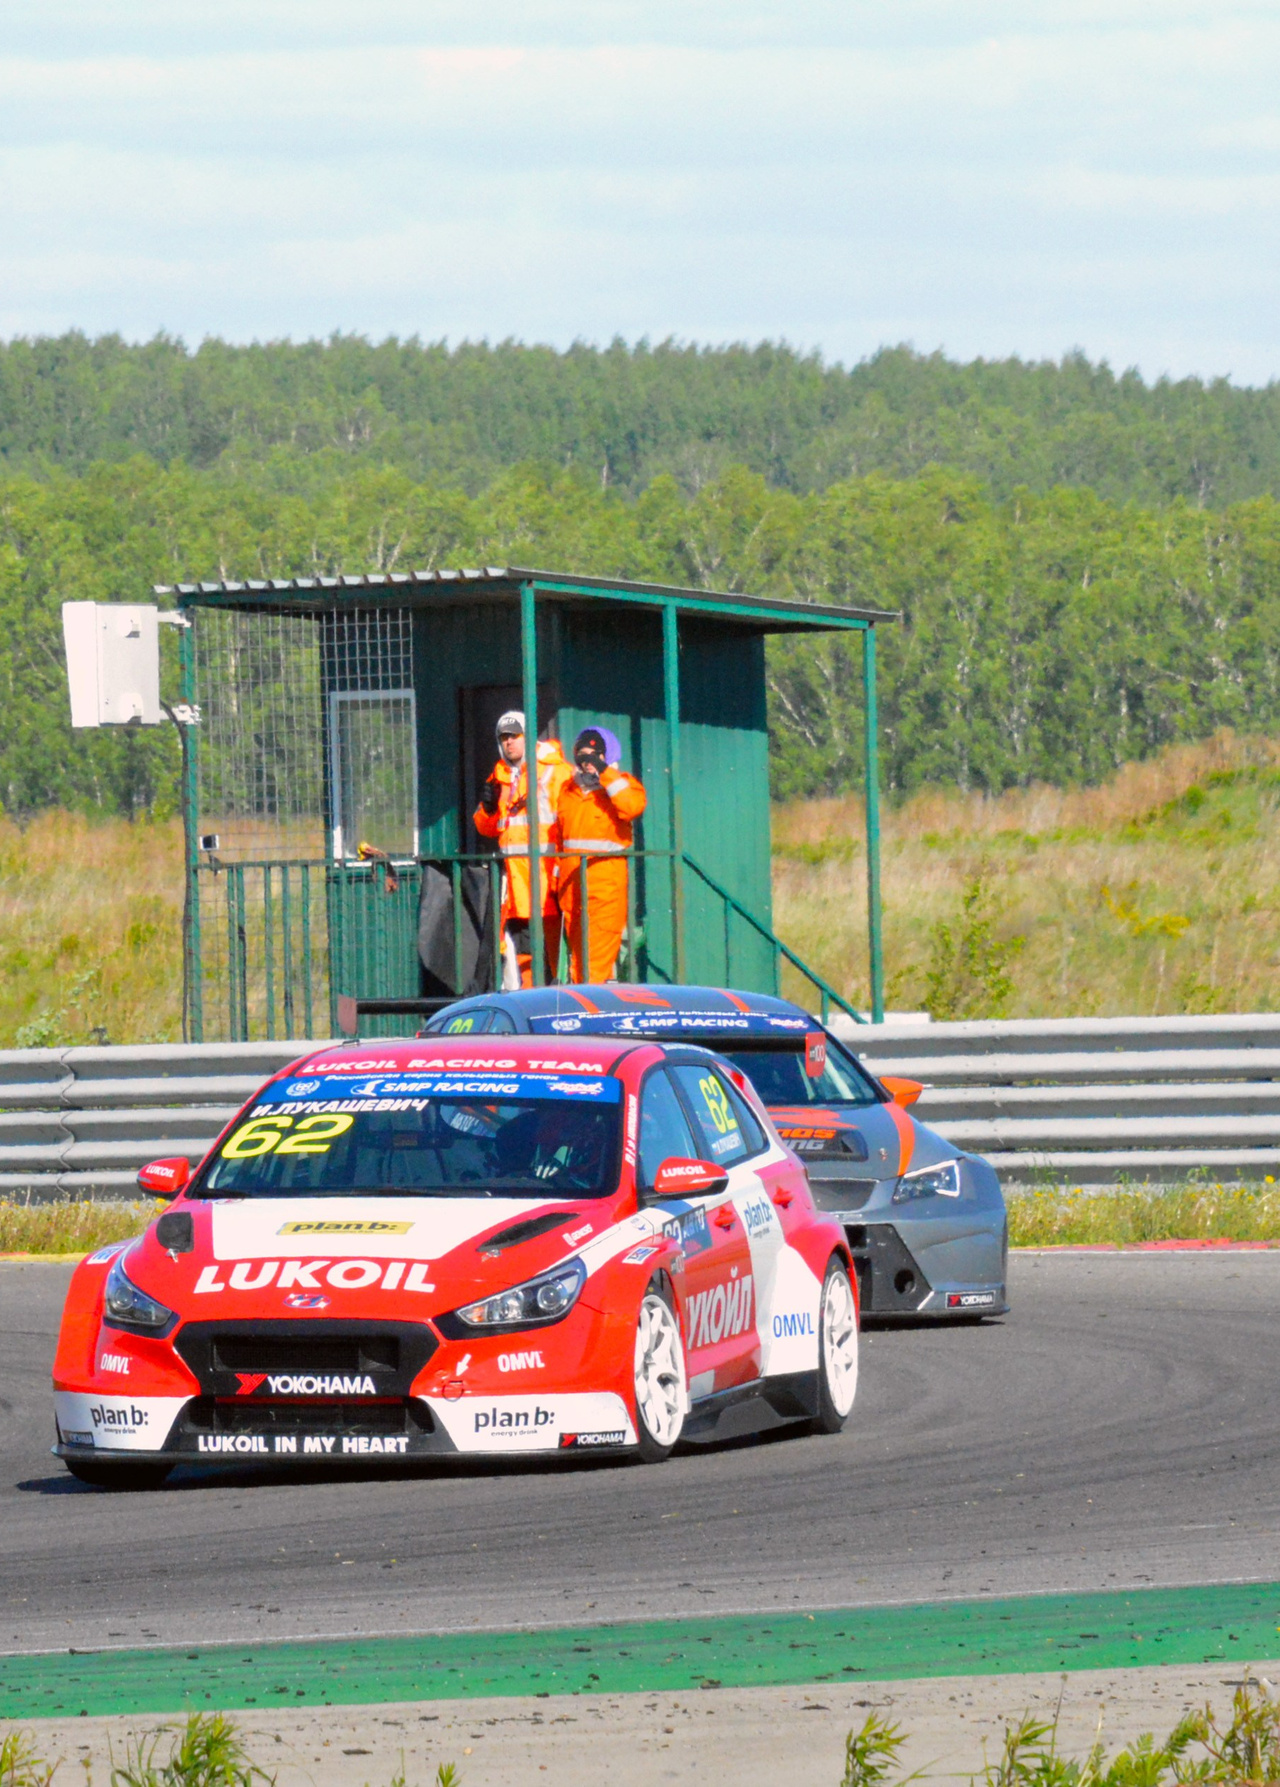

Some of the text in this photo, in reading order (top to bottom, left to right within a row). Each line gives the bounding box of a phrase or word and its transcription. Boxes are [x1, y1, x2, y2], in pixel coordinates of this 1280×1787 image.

[639, 1018, 749, 1028] SMP RACING
[302, 1059, 603, 1073] LUKOIL RACING TEAM
[324, 1073, 400, 1081] Российская
[403, 1072, 442, 1080] серия
[381, 1080, 520, 1094] SMP RACING
[250, 1098, 430, 1119] И.ЛУКАШЕВИЧ
[699, 1075, 737, 1134] 62
[221, 1113, 354, 1159] 62
[145, 1164, 175, 1178] LUKOIL
[661, 1165, 706, 1178] LUKOIL
[292, 1222, 364, 1232] plan
[194, 1260, 437, 1293] LUKOIL
[686, 1265, 754, 1351] УКОЙЛ
[773, 1312, 815, 1338] OMVL
[100, 1353, 130, 1375] OMVL
[497, 1351, 545, 1373] OMVL
[267, 1375, 376, 1395] YOKOHAMA
[90, 1404, 128, 1428] plan
[474, 1406, 555, 1433] plan b:
[198, 1435, 410, 1453] LUKOIL IN MY HEART
[577, 1433, 623, 1445] YOKOHAMA
